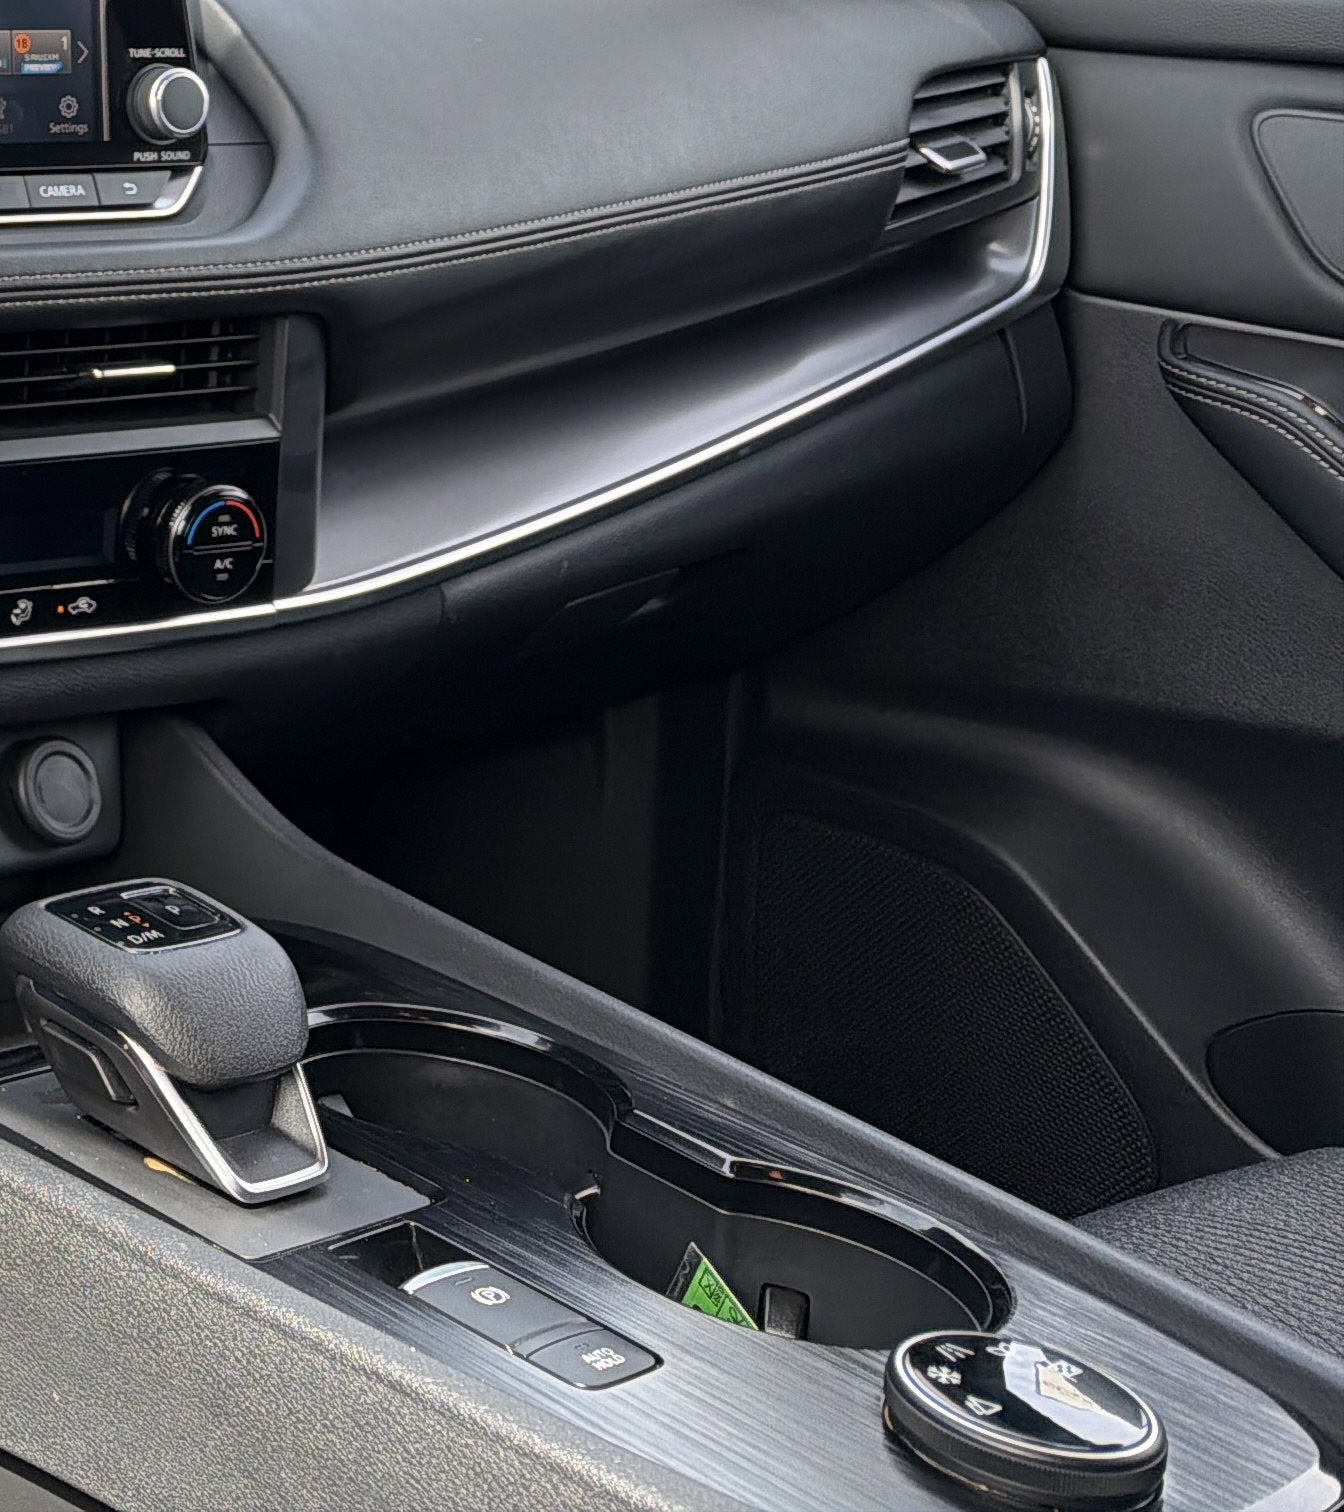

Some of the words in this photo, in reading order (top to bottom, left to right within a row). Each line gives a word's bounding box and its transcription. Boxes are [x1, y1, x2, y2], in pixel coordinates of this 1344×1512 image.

[61, 35, 68, 51] 1
[48, 122, 89, 136] Settings
[133, 151, 158, 162] PUSH
[160, 150, 191, 161] SOUND
[39, 183, 86, 198] CAMERA
[211, 523, 238, 538] SYNC
[213, 557, 234, 570] A/C
[87, 905, 106, 916] R
[165, 905, 180, 916] P
[109, 918, 130, 929] N
[126, 929, 165, 945] D/M
[581, 1346, 613, 1364] AUTO
[591, 1353, 626, 1371] HOLD
